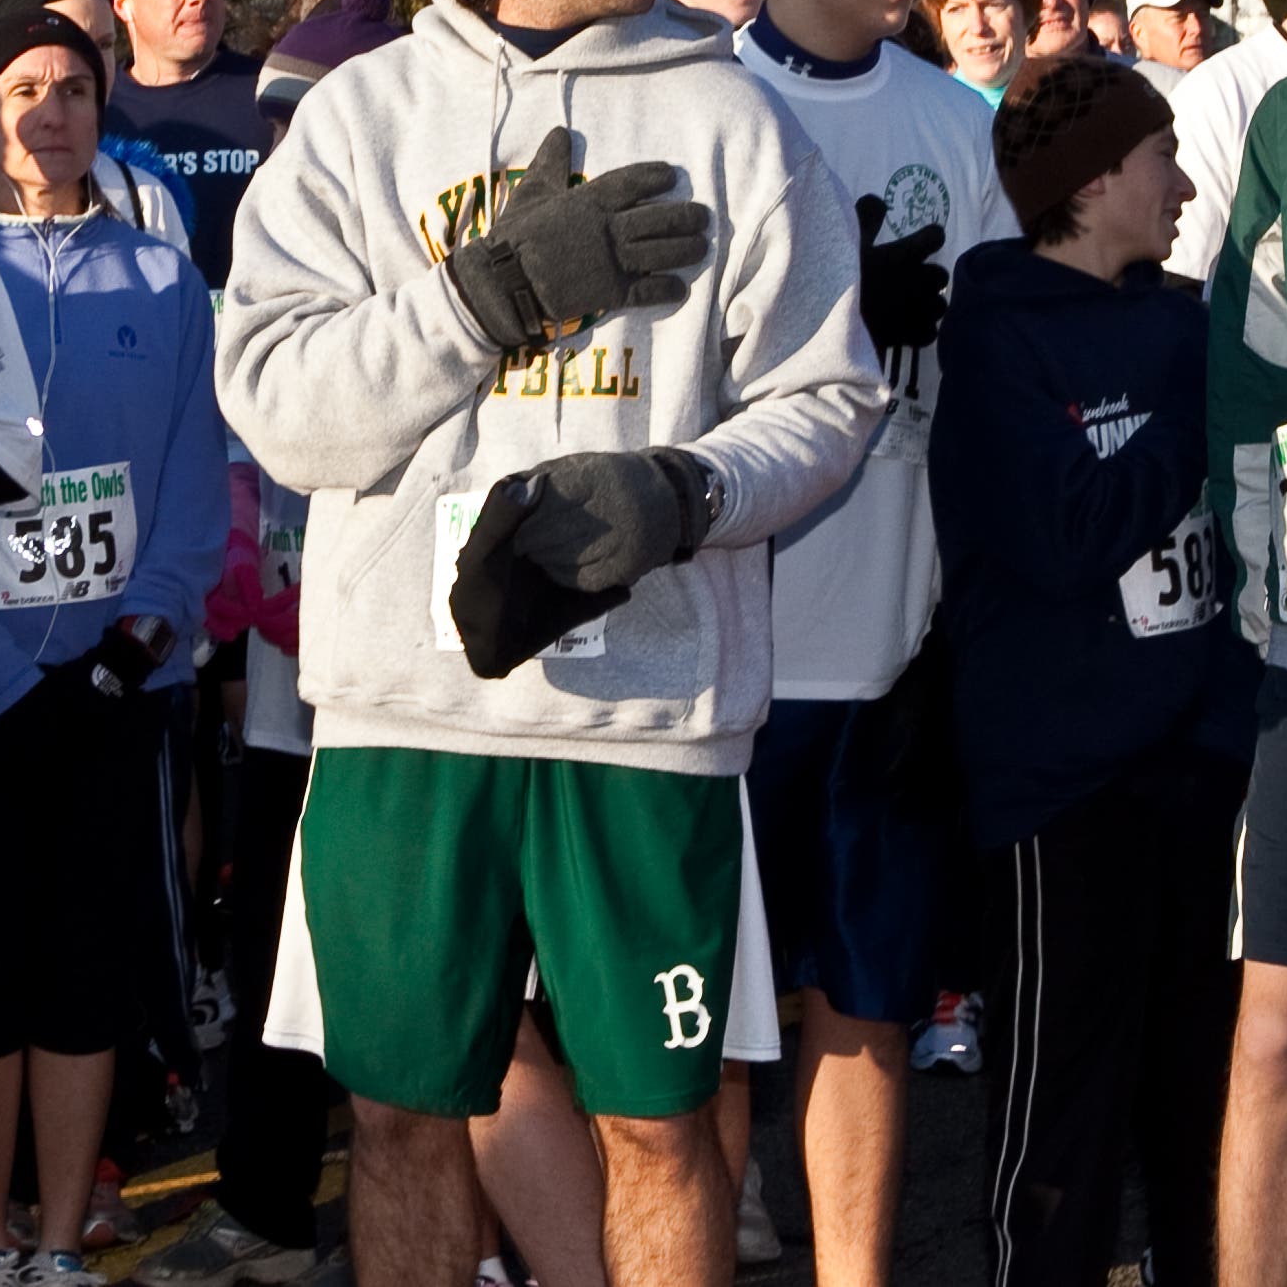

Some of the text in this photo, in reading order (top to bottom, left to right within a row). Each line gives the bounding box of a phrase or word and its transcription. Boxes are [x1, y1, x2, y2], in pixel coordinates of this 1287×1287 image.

[203, 149, 259, 173] STOP
[60, 476, 88, 504] the
[91, 470, 125, 501] Owls
[15, 510, 116, 583] 585
[653, 964, 712, 1049] B
